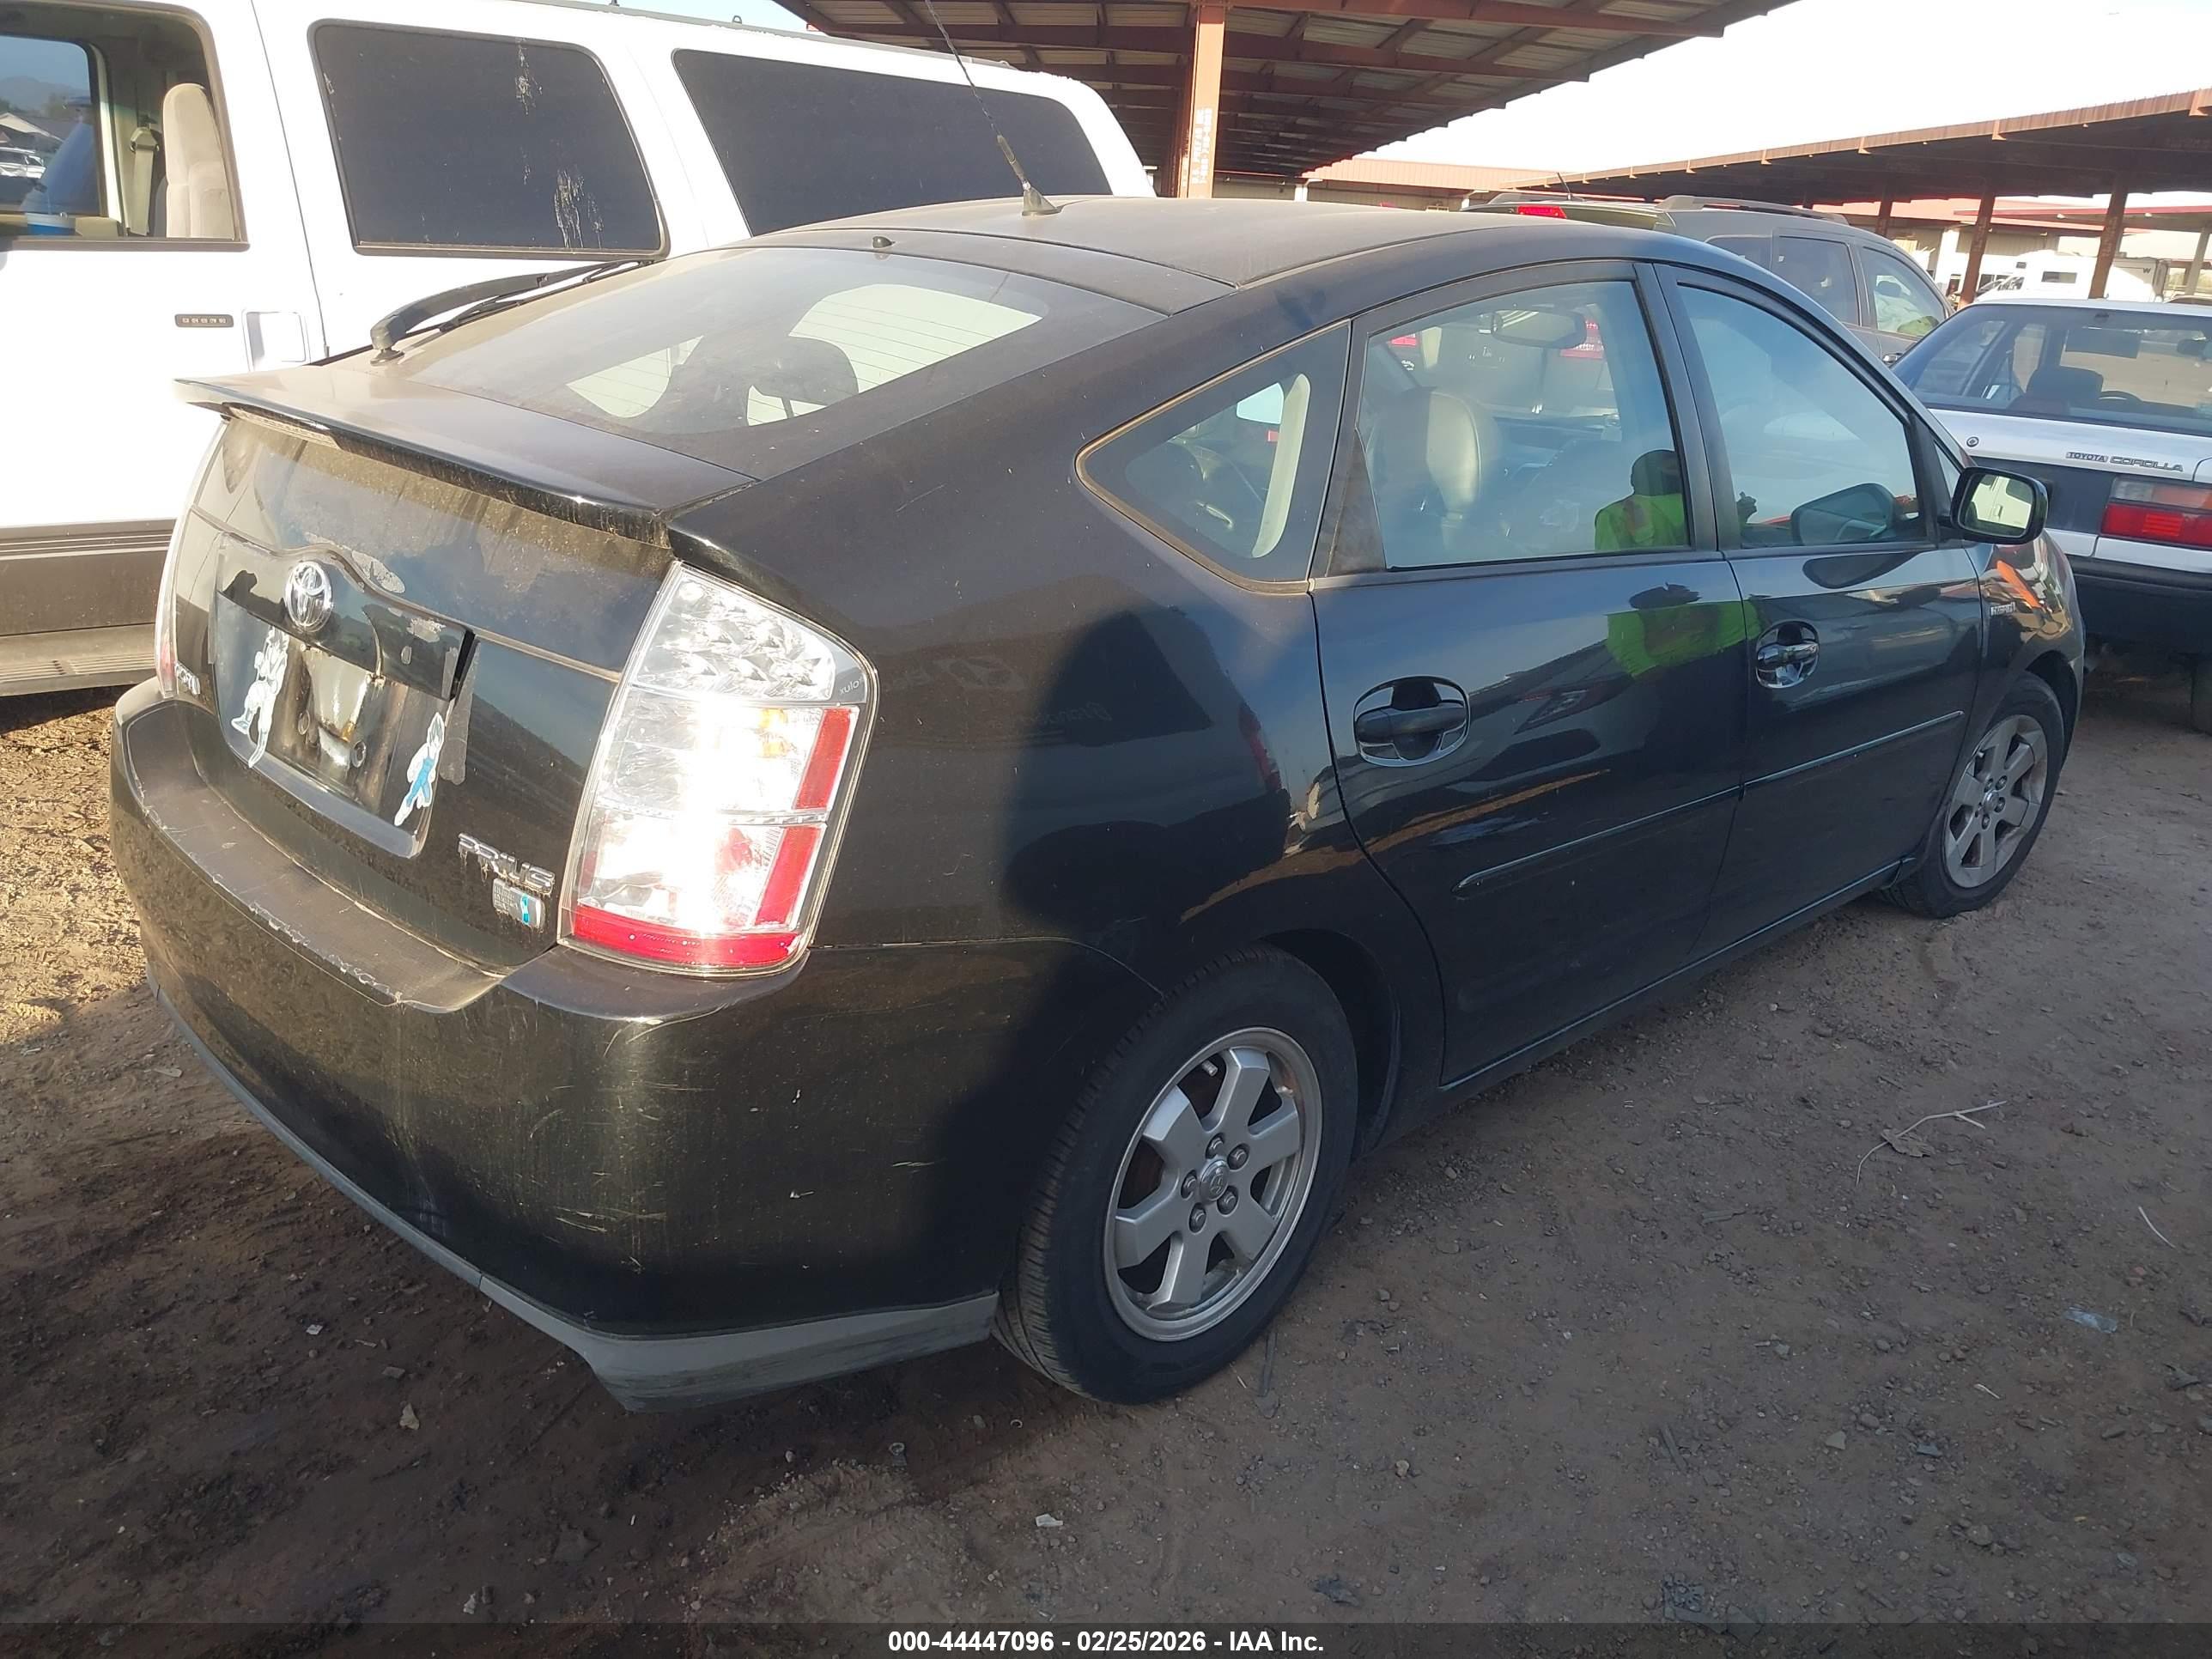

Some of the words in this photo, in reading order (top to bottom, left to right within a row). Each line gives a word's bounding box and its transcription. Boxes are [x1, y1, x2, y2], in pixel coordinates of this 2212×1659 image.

[2068, 452, 2106, 463] TOYOTA
[2109, 455, 2184, 472] COROLLA
[458, 832, 556, 894] PRIUS
